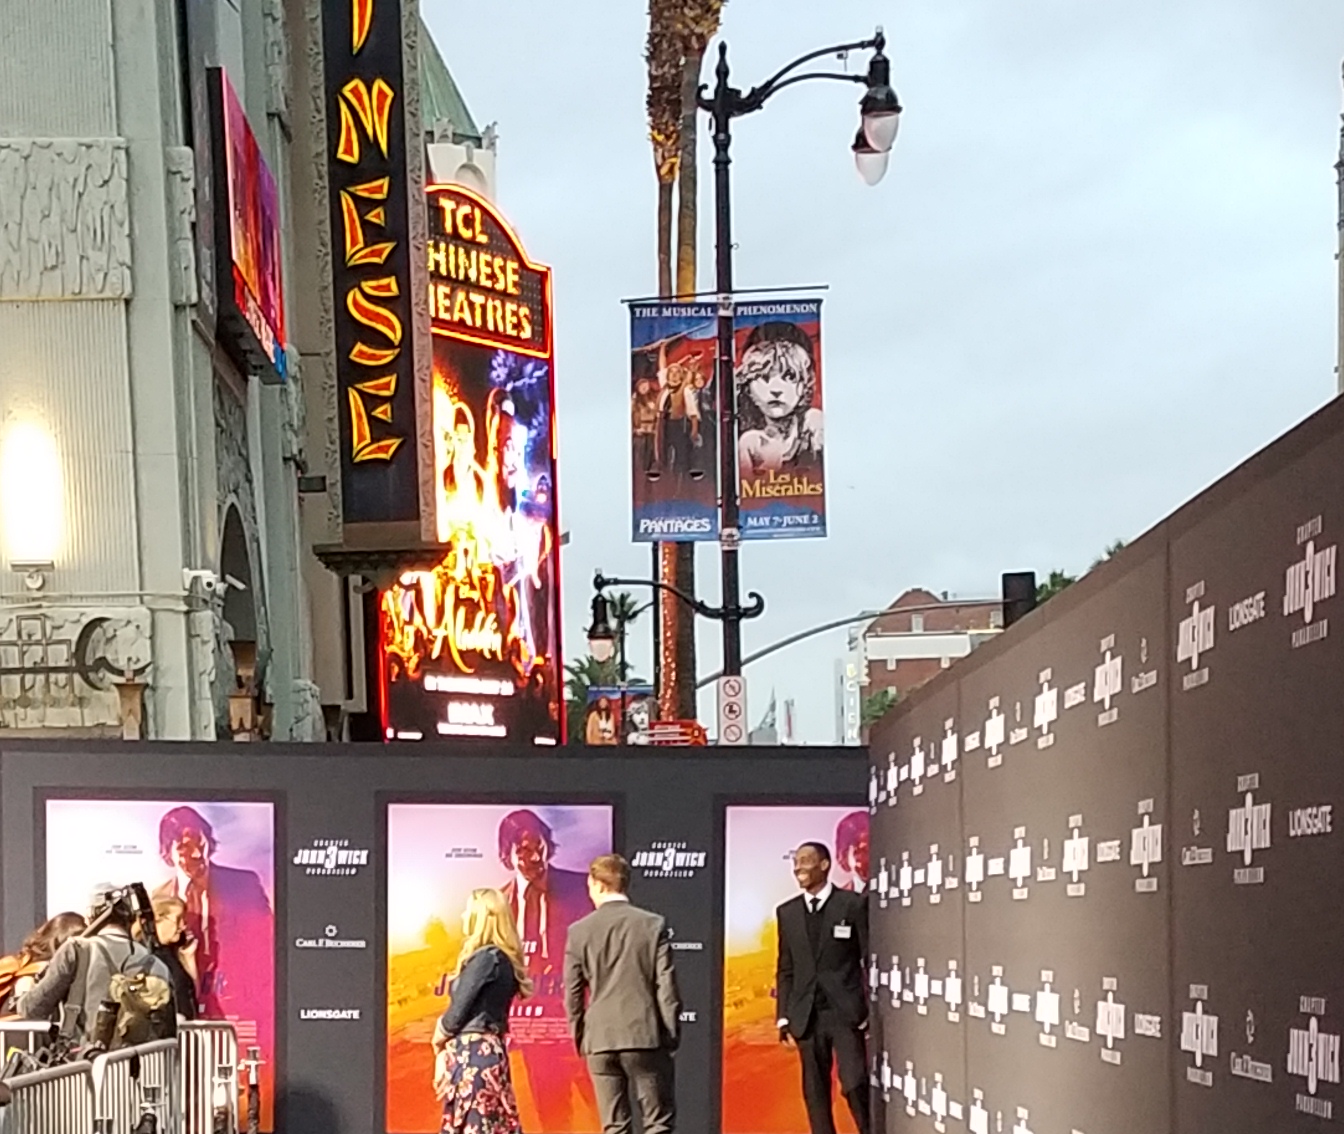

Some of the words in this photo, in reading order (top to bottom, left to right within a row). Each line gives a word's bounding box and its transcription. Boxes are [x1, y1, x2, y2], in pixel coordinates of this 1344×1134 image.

[439, 197, 488, 243] TCL
[427, 240, 520, 295] HINESE
[428, 283, 532, 340] EATRES
[635, 306, 659, 317] THE
[662, 306, 714, 318] MUSICAL
[736, 303, 818, 316] PHENOMENON
[769, 469, 791, 484] Les
[640, 517, 712, 533] PANTAGES
[747, 516, 771, 527] MAY
[811, 515, 819, 524] 2
[337, 849, 369, 865] WICK
[675, 852, 706, 867] WICK
[300, 1009, 360, 1020] LIONSGATE
